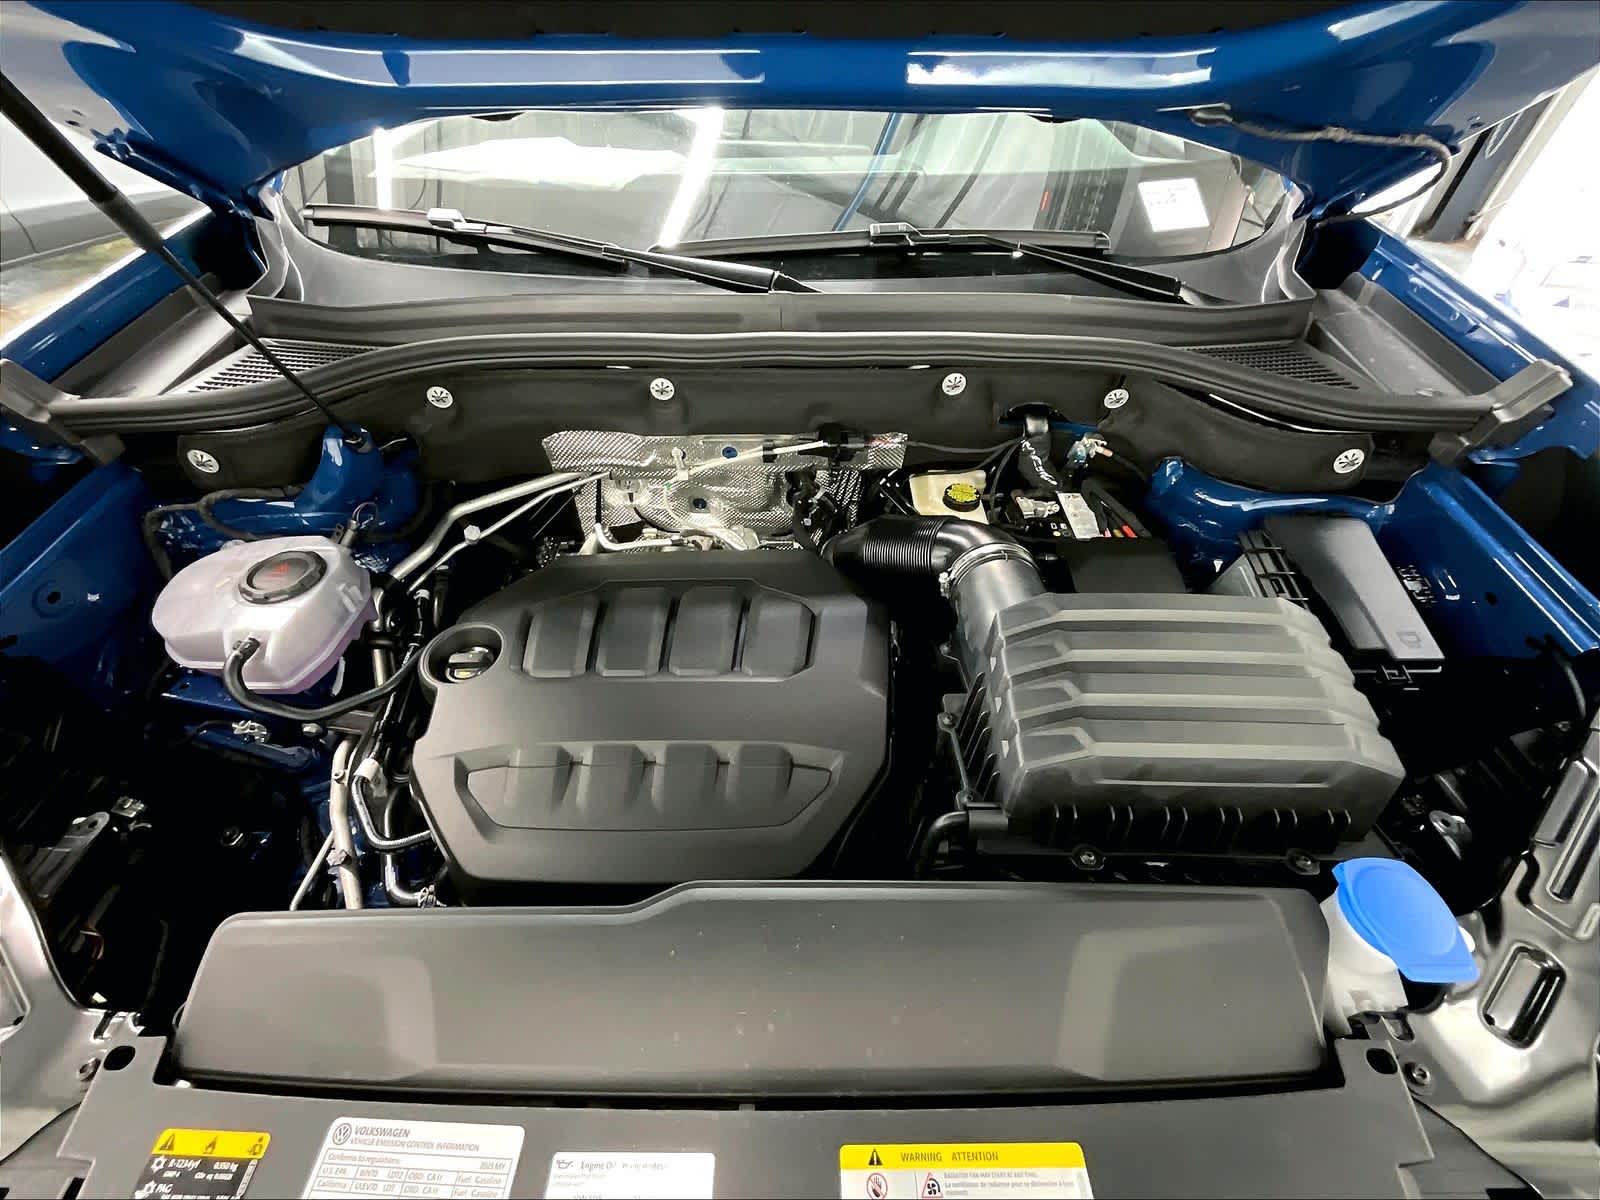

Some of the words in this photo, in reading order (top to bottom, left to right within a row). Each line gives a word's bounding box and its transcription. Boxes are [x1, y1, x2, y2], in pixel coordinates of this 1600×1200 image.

[354, 1126, 410, 1138] VOLKSWAGEN
[900, 1151, 942, 1162] WARNING
[951, 1151, 999, 1161] ATTENTION
